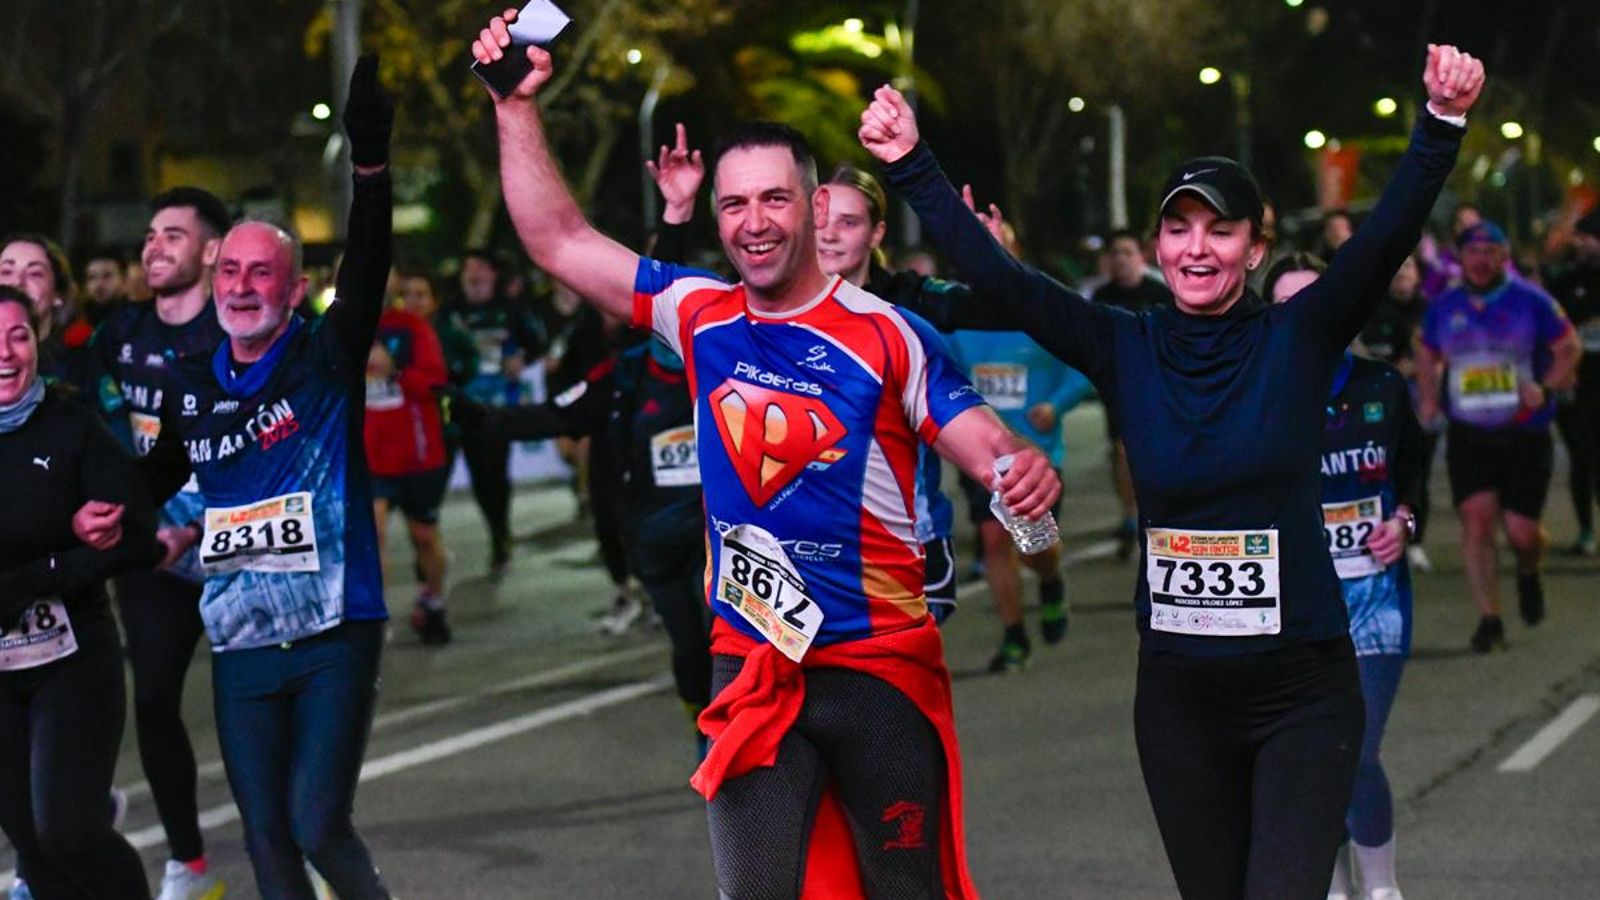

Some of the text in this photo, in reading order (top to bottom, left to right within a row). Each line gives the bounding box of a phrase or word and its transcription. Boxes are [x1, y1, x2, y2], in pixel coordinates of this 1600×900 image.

[734, 361, 823, 396] Pikaeras
[183, 438, 212, 464] AN
[660, 441, 698, 465] 69
[211, 518, 303, 553] 8318
[731, 553, 811, 630] 7198
[1156, 558, 1265, 596] 7333
